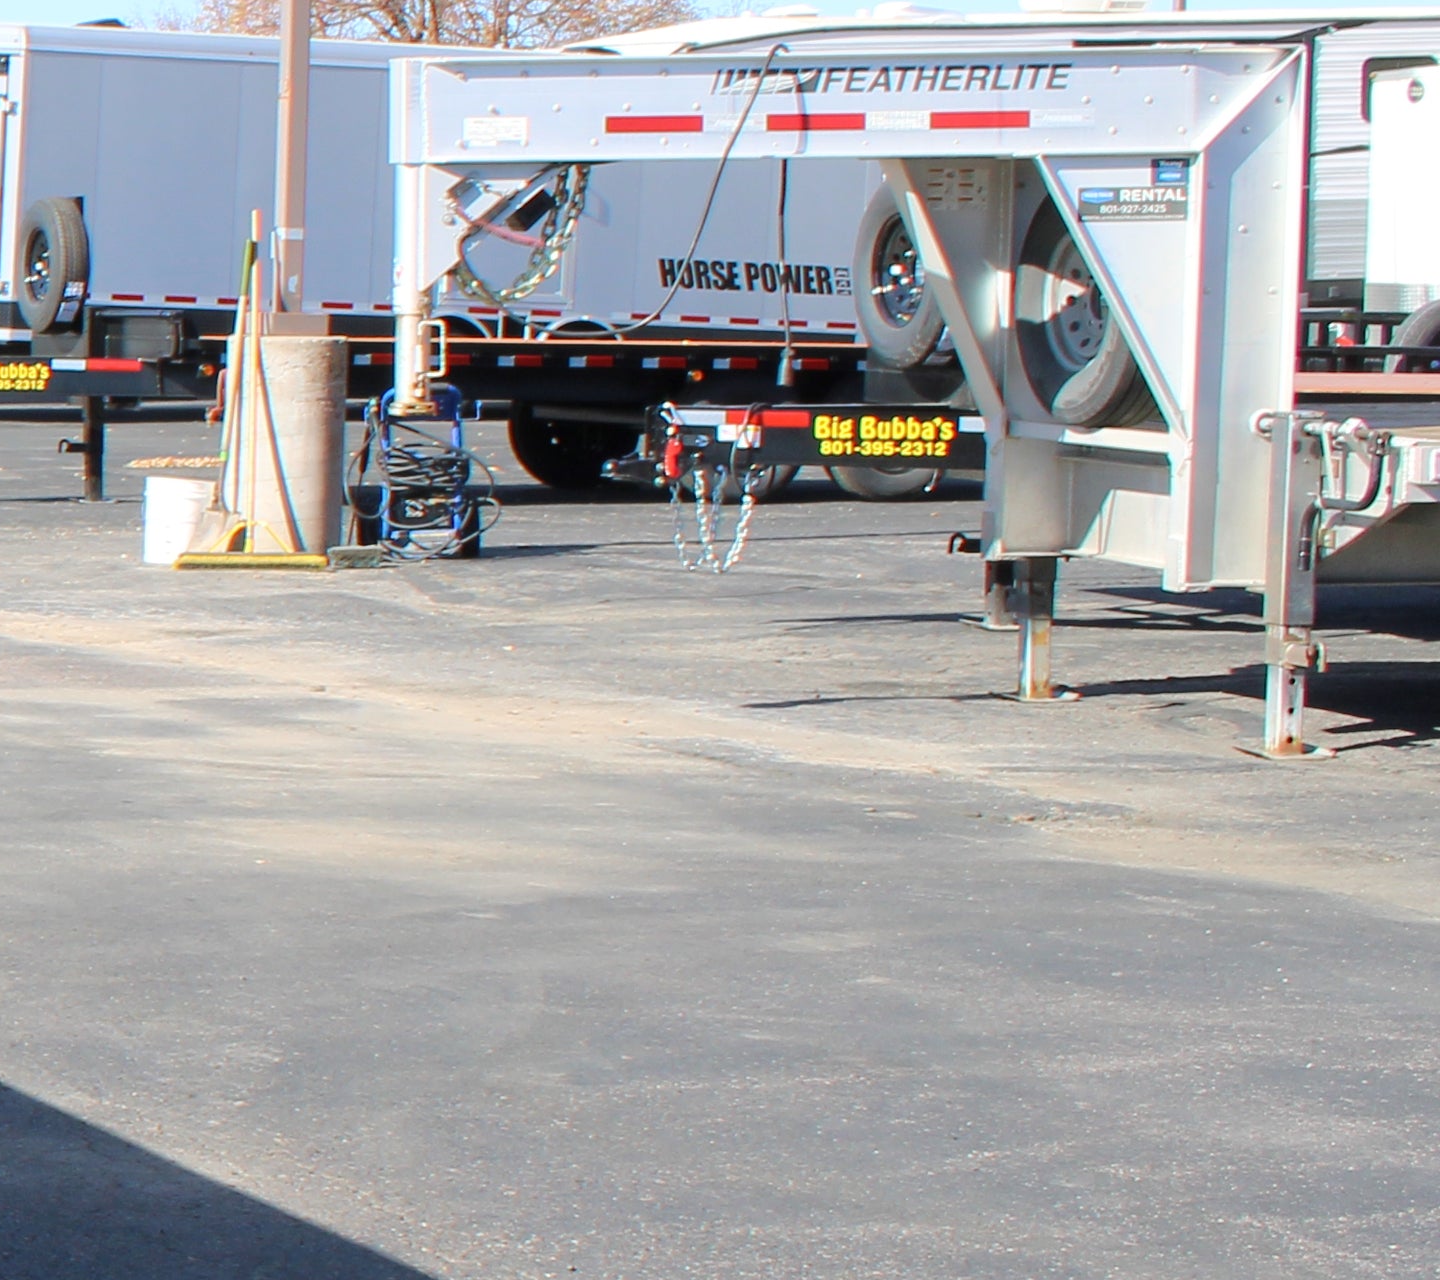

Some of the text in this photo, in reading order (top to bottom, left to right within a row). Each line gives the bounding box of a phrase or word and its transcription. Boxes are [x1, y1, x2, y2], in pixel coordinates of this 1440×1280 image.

[820, 62, 1073, 94] FEATHERLITE
[1119, 187, 1187, 203] RENTAL
[658, 257, 741, 292] HORSE
[743, 262, 834, 296] POWER
[813, 415, 956, 441] Big Bubba's
[819, 440, 948, 457] 801-395-2312
